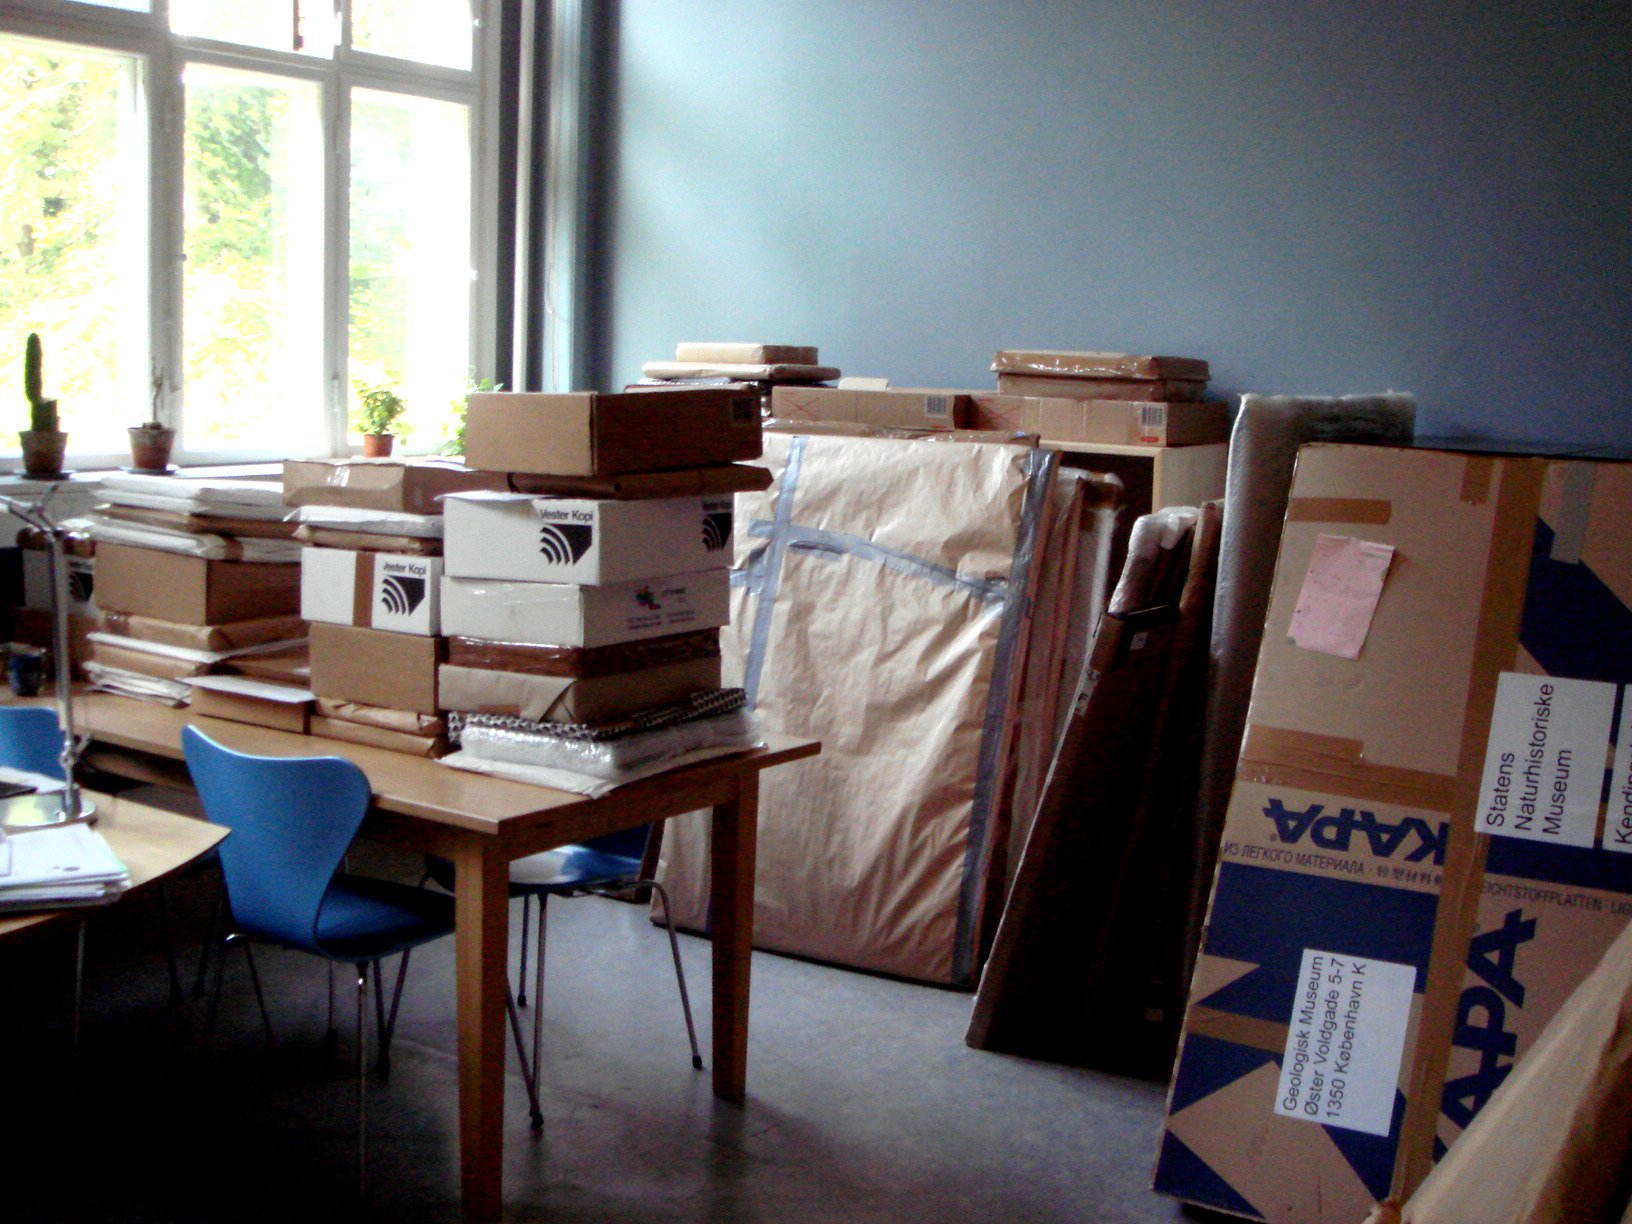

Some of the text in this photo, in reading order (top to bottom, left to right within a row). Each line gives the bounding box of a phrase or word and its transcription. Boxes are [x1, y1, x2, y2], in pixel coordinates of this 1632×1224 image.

[571, 510, 593, 523] Kopi
[1486, 752, 1515, 827] Statens
[1514, 683, 1554, 831] Naturhistoriske
[1542, 749, 1572, 835] Museum
[1223, 841, 1365, 874] ИЗ ЛЕГКОГО МАТЕРИАЛА
[1263, 798, 1450, 866] KAPA
[1482, 880, 1602, 911] EICHTSTOFFPLATTEN
[1282, 955, 1324, 1111] Geologisk Museum
[1304, 957, 1346, 1116] Øster Voldgade 5-7
[1326, 961, 1368, 1118] 1350 København K
[1432, 908, 1537, 1165] APA
